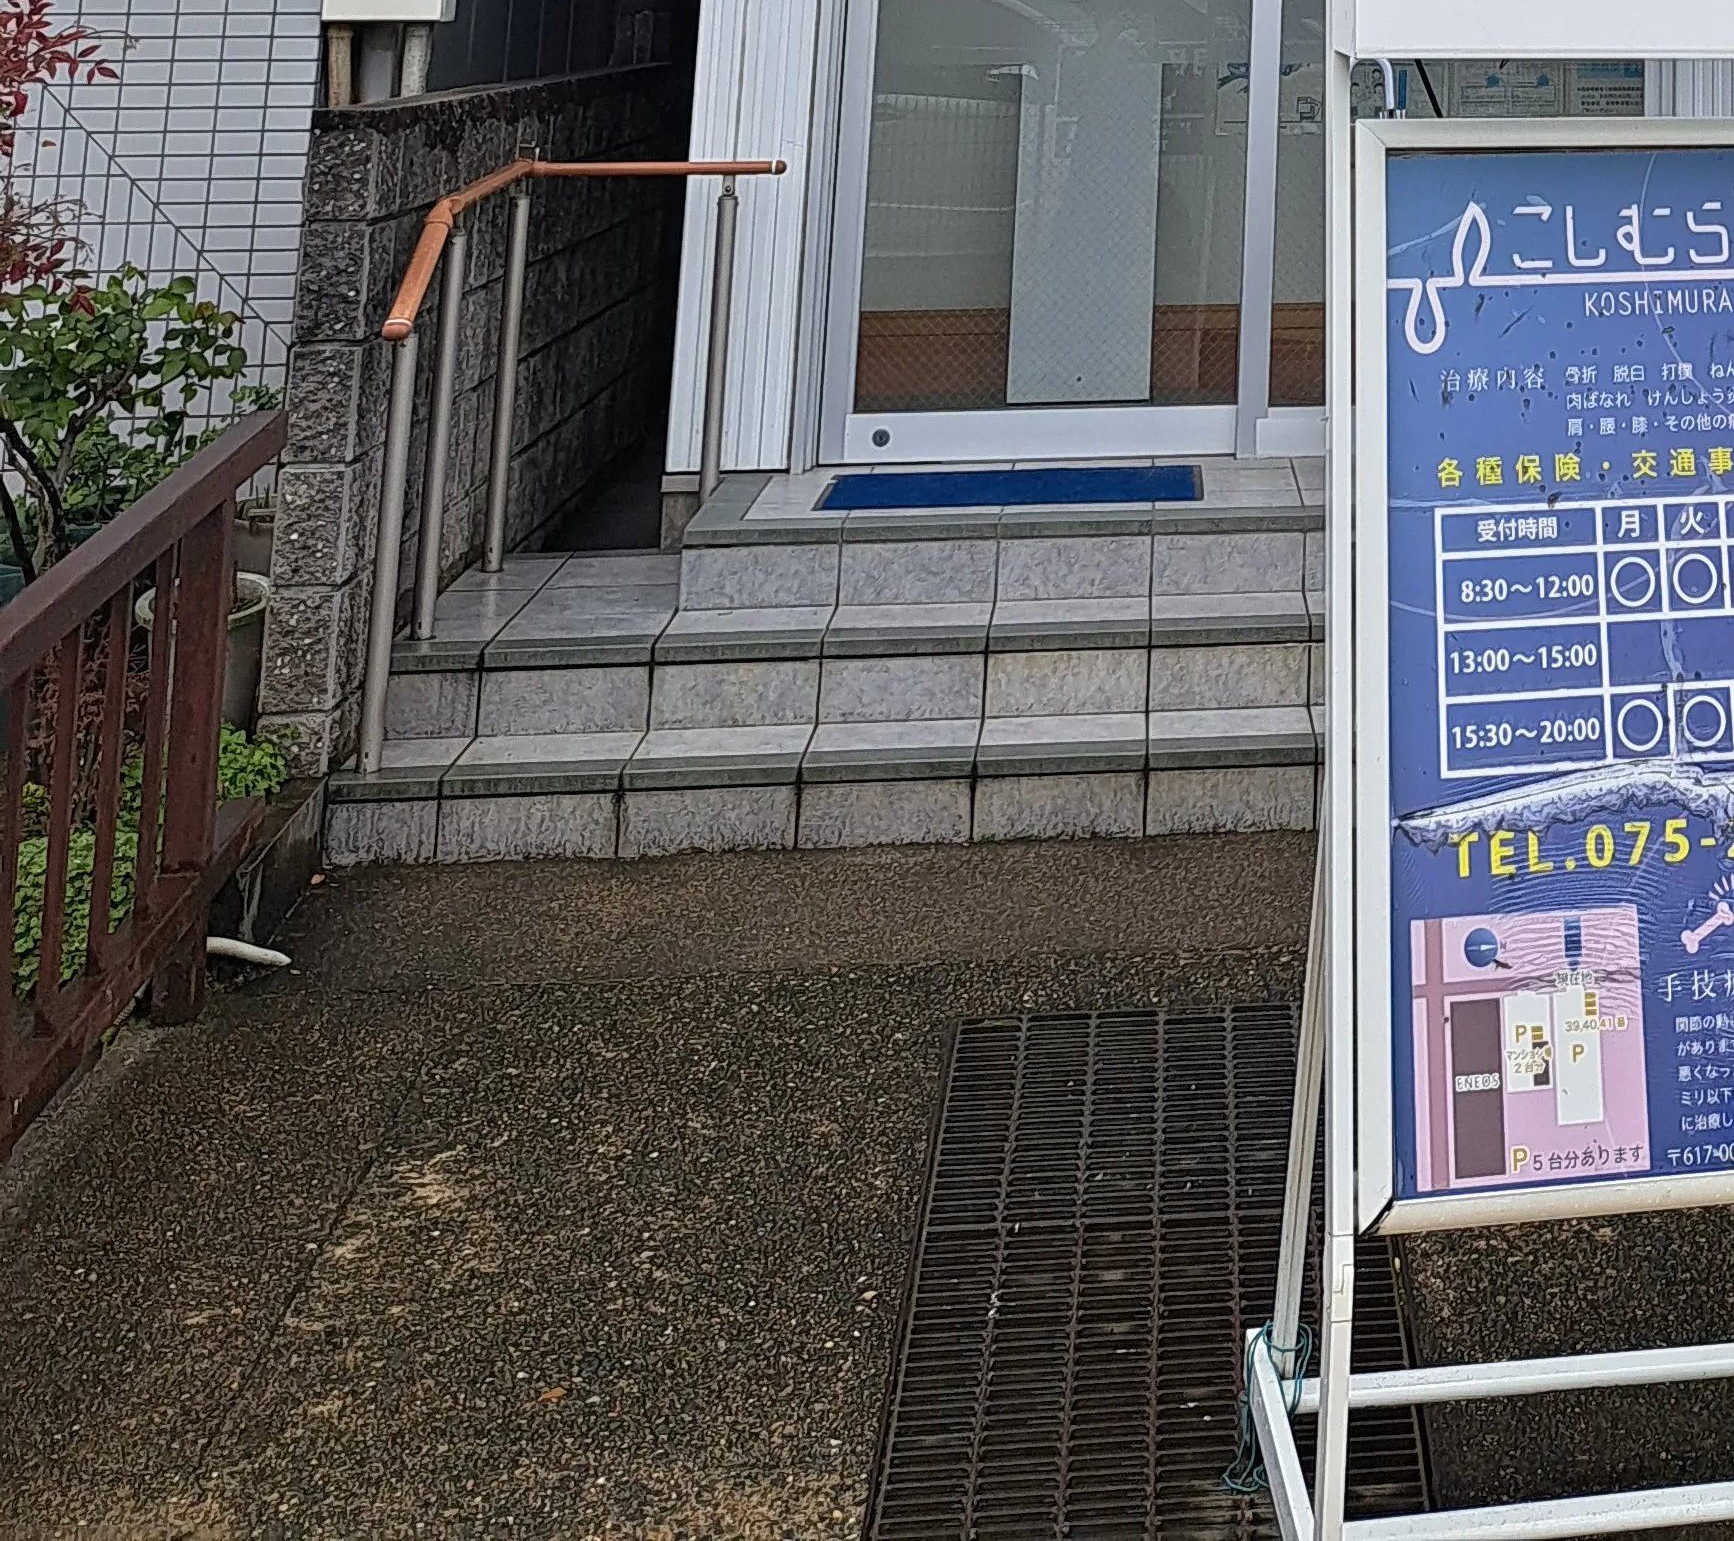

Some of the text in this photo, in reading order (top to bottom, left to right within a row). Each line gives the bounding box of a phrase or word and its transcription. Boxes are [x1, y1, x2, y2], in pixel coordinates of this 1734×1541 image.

[1585, 286, 1733, 317] KOSHIMURA
[1440, 367, 1545, 392] 治療内容
[1566, 389, 1632, 410] 肉ばなれ
[1477, 515, 1559, 542] 受付時間
[1617, 508, 1643, 537] 月
[1679, 507, 1706, 535] 火
[1515, 1024, 1527, 1043] P
[1572, 1044, 1584, 1063] P
[1457, 1075, 1499, 1090] ENEOS
